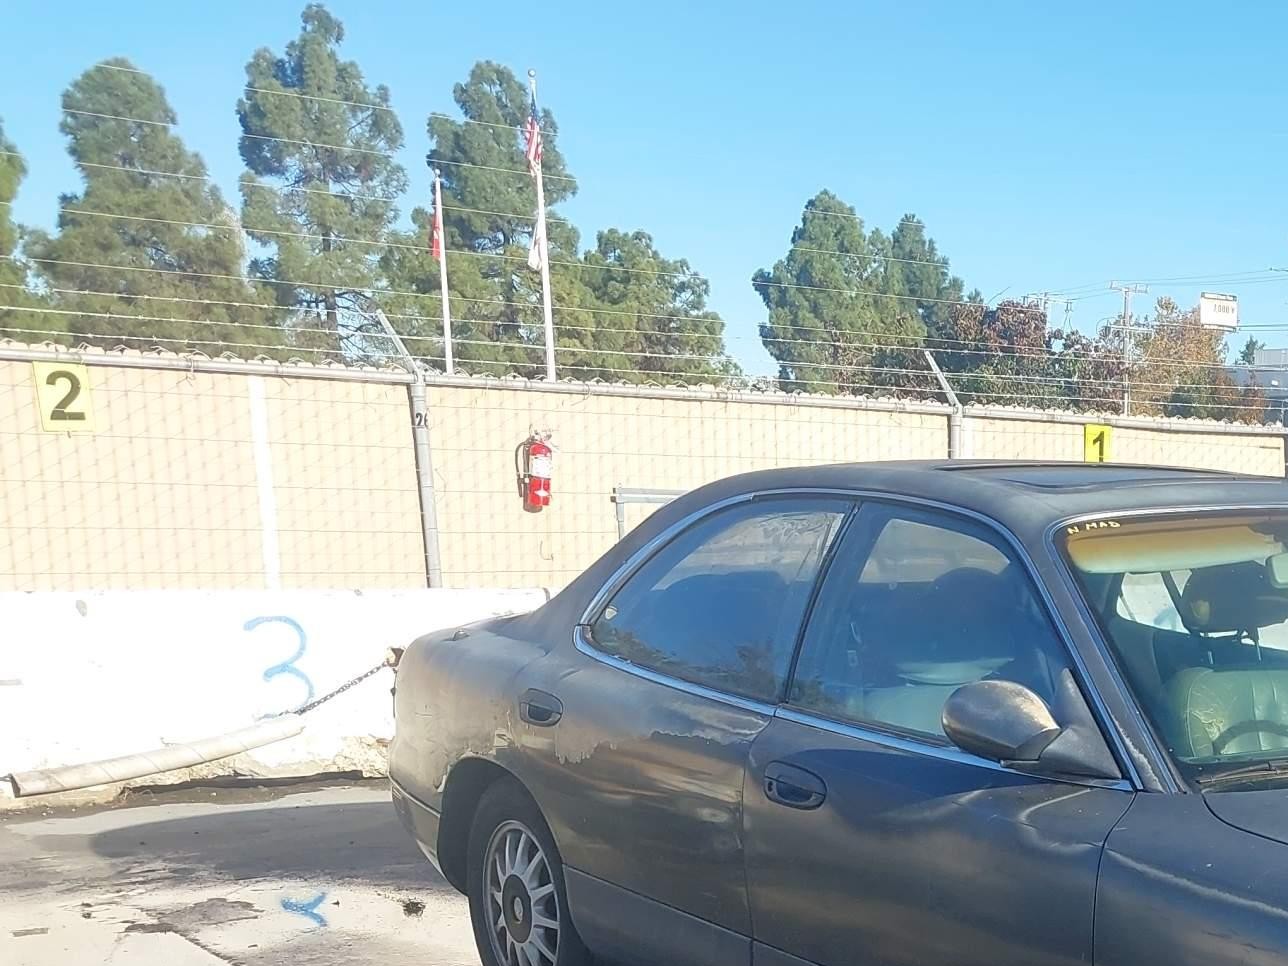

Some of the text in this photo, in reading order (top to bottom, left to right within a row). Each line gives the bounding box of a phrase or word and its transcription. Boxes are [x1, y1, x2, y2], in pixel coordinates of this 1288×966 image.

[46, 370, 86, 420] 2
[1092, 430, 1104, 463] 1
[243, 615, 314, 719] 3
